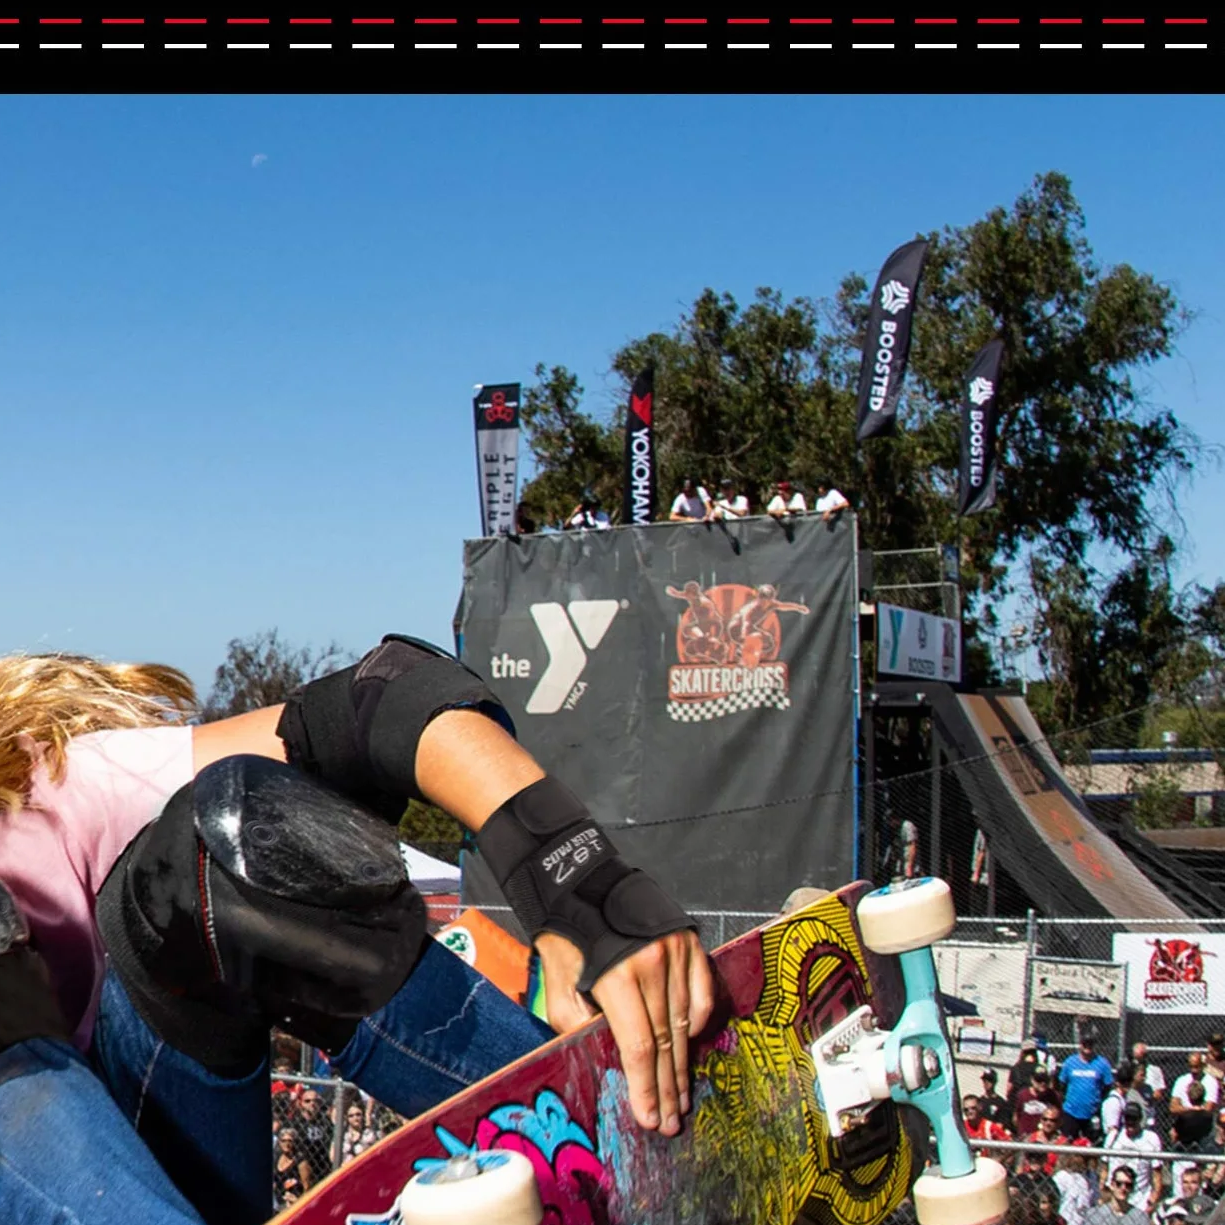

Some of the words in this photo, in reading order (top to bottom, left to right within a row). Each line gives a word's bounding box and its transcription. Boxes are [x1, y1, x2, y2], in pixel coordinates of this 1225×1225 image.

[869, 319, 897, 412] BOOSTED
[970, 410, 984, 488] BOOSTED
[490, 652, 531, 679] the
[670, 666, 785, 695] SKATERCROSS
[563, 681, 588, 710] YMCA
[542, 841, 574, 872] PADS
[555, 839, 603, 884] 187
